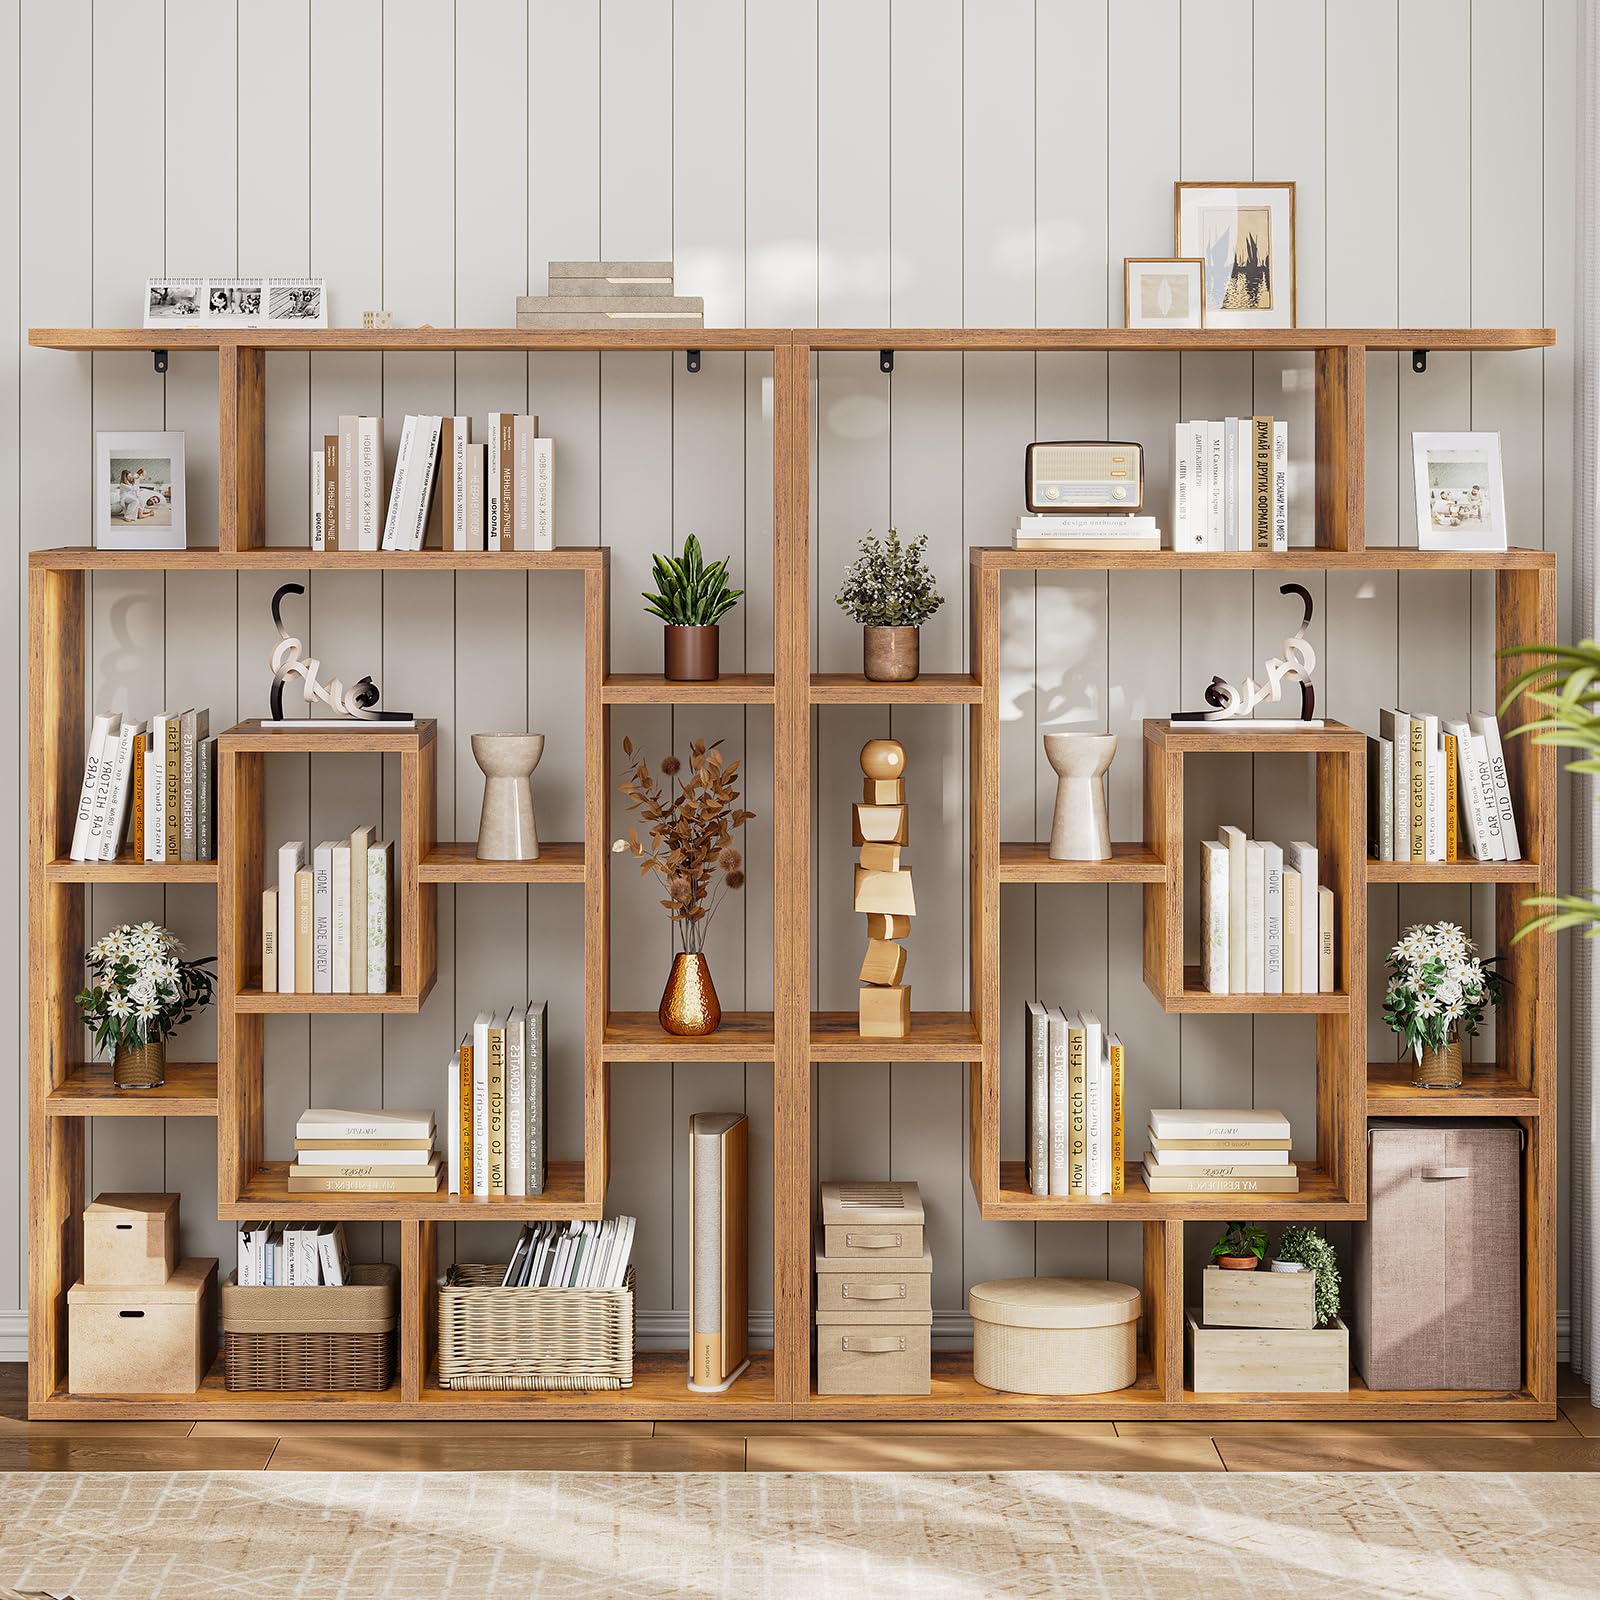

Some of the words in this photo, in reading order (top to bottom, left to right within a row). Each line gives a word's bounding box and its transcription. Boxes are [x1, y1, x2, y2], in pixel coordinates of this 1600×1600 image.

[1257, 421, 1271, 451] ДУМАЙ
[363, 434, 372, 467] НОВЫЙ
[539, 453, 547, 480] НОВЫЙ
[1256, 460, 1268, 493] ДРУГИХ
[363, 470, 372, 498] ОБРАЗ
[539, 483, 547, 507] ОБРАЗ
[1276, 471, 1285, 503] РАССКАЖИ
[363, 501, 372, 534] ЖИЗНИ
[490, 498, 498, 538] ШОКОЛАД
[503, 502, 511, 539] ЛУЧШЕ
[539, 509, 547, 537] ЖИЗНИ
[1258, 495, 1268, 540] ФОРМАТАХ
[1276, 505, 1285, 518] МНЕ
[1276, 524, 1285, 542] МОРЕ
[1412, 726, 1423, 752] fish
[1398, 734, 1408, 784] DECORATES
[1492, 756, 1507, 789] CARS
[1413, 774, 1423, 808] catch
[1478, 760, 1495, 809] HISTORY
[1398, 789, 1408, 839] HOUSEHOLD
[1413, 815, 1423, 827] to
[1448, 804, 1455, 813] by
[1475, 807, 1484, 826] DRAW
[1500, 796, 1513, 821] OLD
[1479, 829, 1486, 839] TO
[1488, 815, 1500, 836] CAR
[1413, 835, 1423, 856] How
[1481, 842, 1489, 857] HOW
[317, 869, 327, 895] HOME
[317, 916, 327, 940] MADE
[265, 931, 273, 955] TEXTURES
[317, 944, 327, 974] LOVELY
[1071, 1036, 1083, 1067] fish
[1055, 1045, 1065, 1104] DECORATES
[1074, 1076, 1083, 1084] a
[1072, 1092, 1083, 1132] catch
[1090, 1080, 1098, 1137] Churchill
[1055, 1110, 1065, 1169] HOUSEHOLD
[1114, 1126, 1122, 1137] by
[1072, 1140, 1083, 1156] to
[1072, 1164, 1083, 1188] How
[1090, 1143, 1098, 1188] Winston
